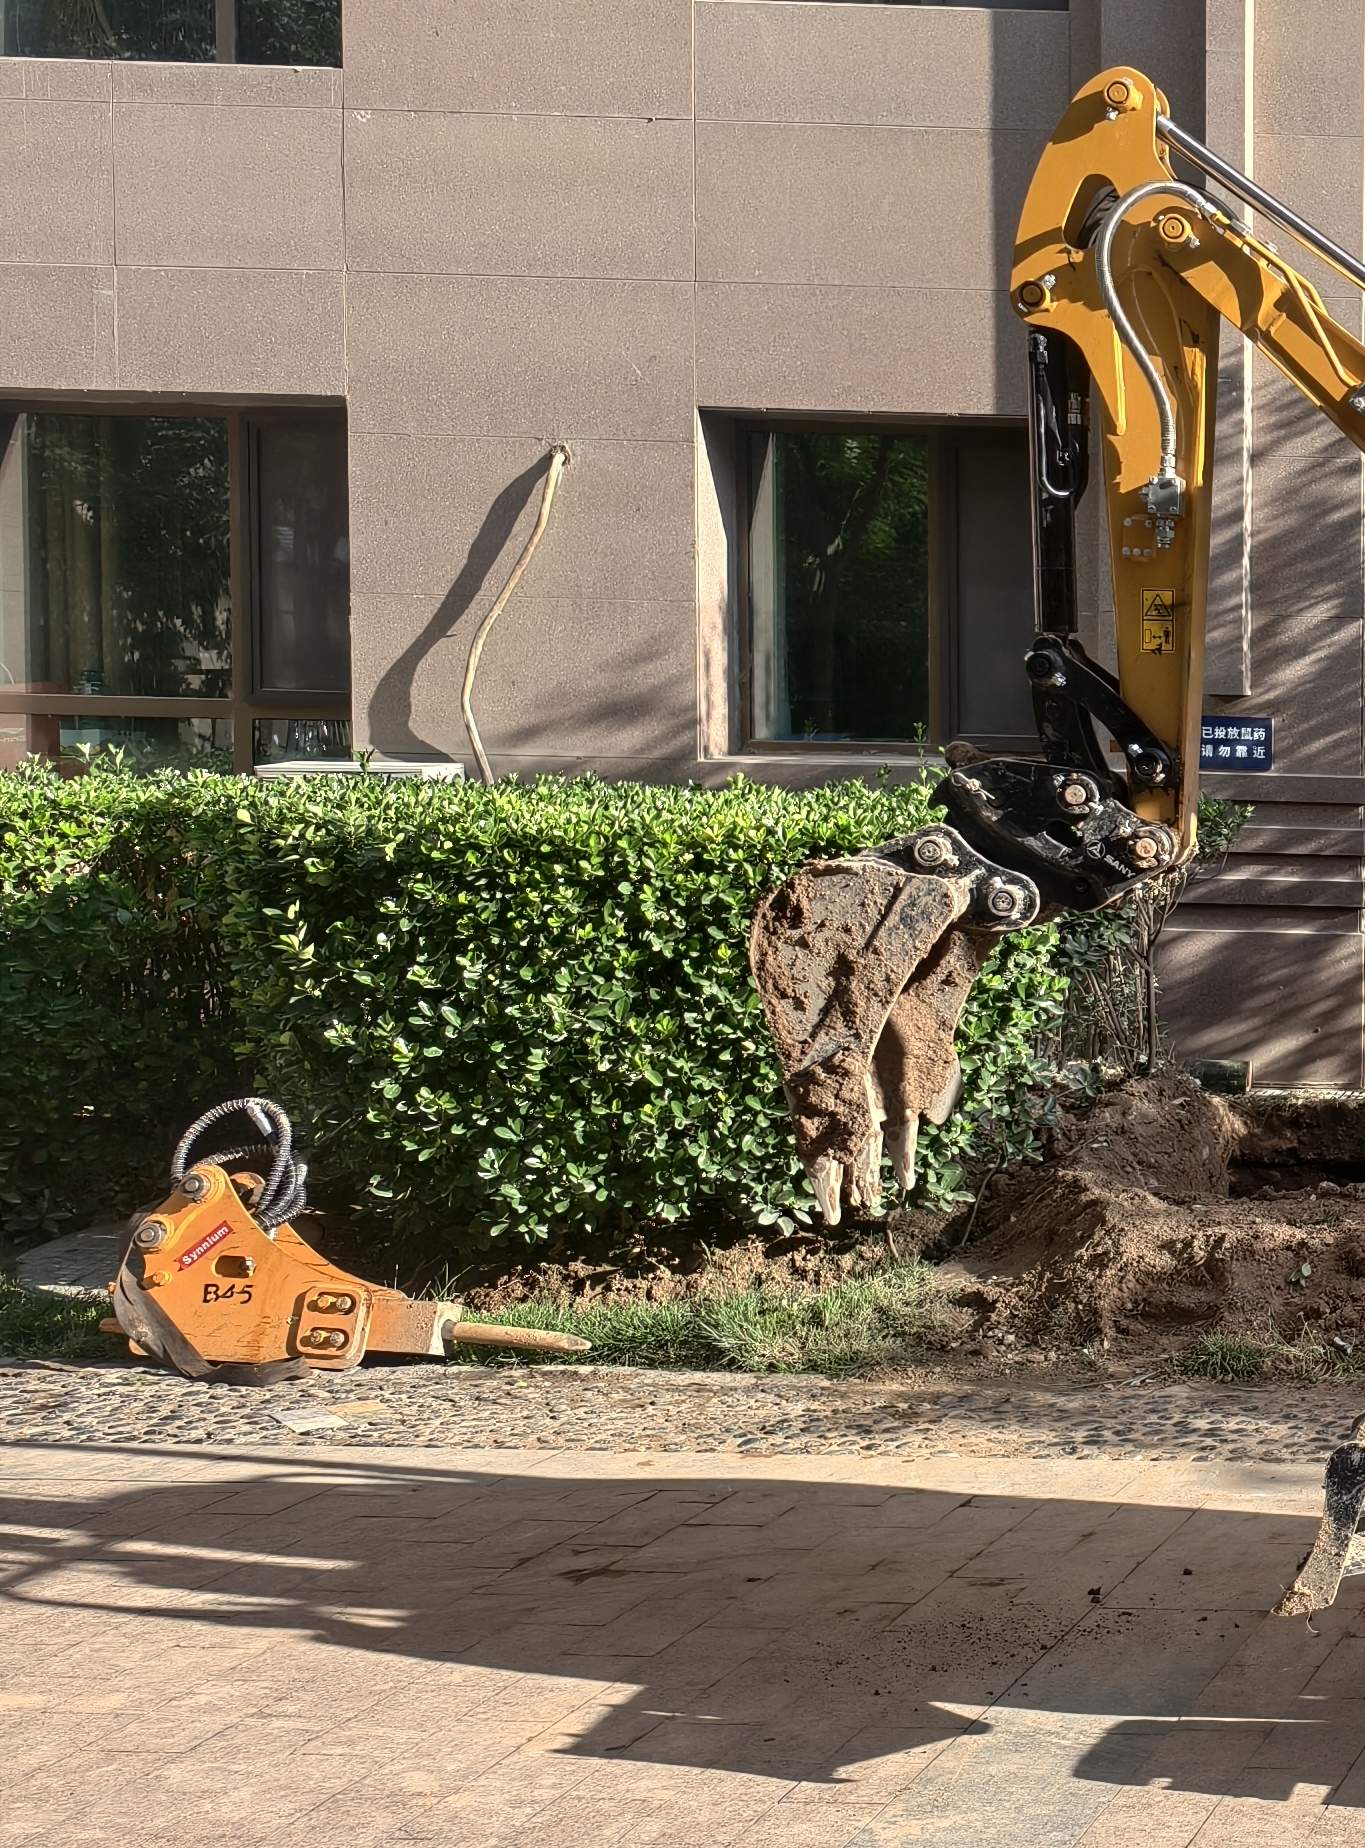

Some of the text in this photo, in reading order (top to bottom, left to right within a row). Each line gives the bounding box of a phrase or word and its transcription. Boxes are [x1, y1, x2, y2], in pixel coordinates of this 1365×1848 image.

[1201, 726, 1266, 741] 已投放鼠药
[1201, 744, 1266, 759] 请勿靠近
[1103, 854, 1137, 878] SANY
[182, 1225, 229, 1265] Synnium
[202, 1283, 254, 1305] B45
